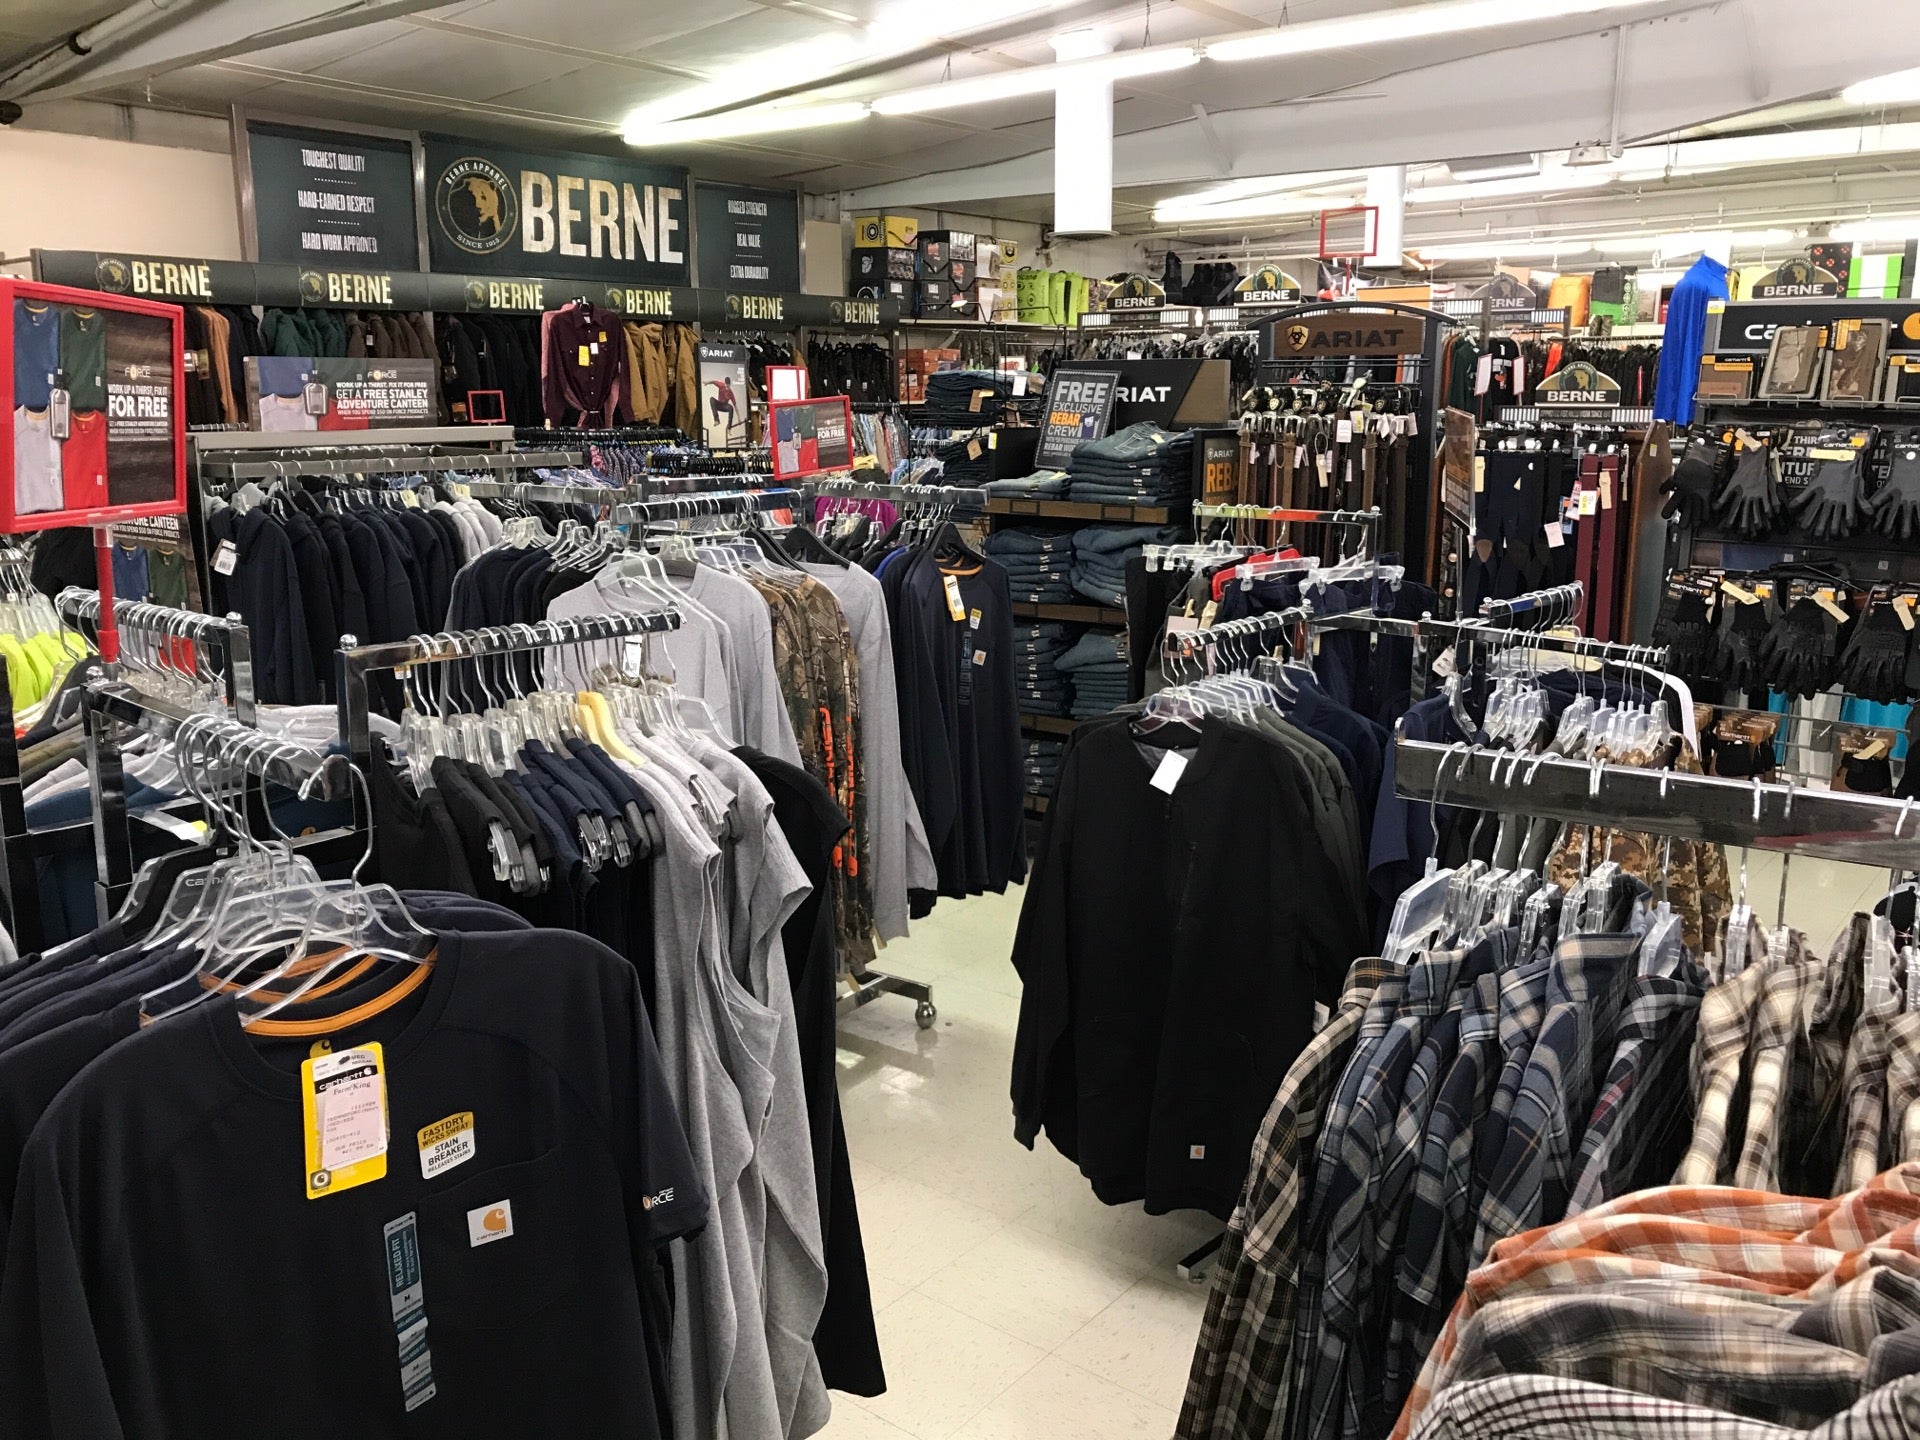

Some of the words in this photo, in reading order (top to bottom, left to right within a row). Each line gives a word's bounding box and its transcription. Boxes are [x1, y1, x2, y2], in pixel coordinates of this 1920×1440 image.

[301, 149, 337, 170] TOUGHEST
[337, 153, 365, 172] QUALITY
[473, 162, 508, 190] APPAREL
[297, 190, 345, 211] HARD-EARNED
[346, 195, 375, 213] RESPECT
[520, 169, 683, 264] BERNE
[301, 232, 321, 250] HARD
[321, 233, 343, 251] WORK
[343, 235, 378, 253] APPROVED
[457, 234, 482, 249] SINCE
[131, 260, 212, 296] BERNE
[327, 272, 393, 304] BERNE
[488, 281, 544, 310] BERNE
[1243, 289, 1290, 302] BERNE
[1763, 284, 1824, 297] BERNE
[625, 288, 672, 316] BERNE
[742, 295, 784, 320] BERNE
[1114, 297, 1156, 308] BERNE
[1490, 298, 1525, 308] ERNE
[844, 300, 880, 325] BERNE
[1311, 329, 1404, 348] ARIAT
[708, 349, 734, 358] ARIAT
[125, 364, 151, 380] FORCE
[367, 369, 397, 381] FORCE
[107, 384, 124, 395] WORK
[124, 384, 131, 395] UP
[131, 385, 135, 395] A
[336, 390, 354, 400] GET
[355, 390, 362, 399] A
[363, 389, 388, 399] FREE
[389, 389, 428, 399] STANLEY
[1055, 381, 1109, 404] FREE
[1116, 386, 1171, 403] RIAT
[1547, 390, 1607, 402] BERNE
[108, 394, 136, 417] FOR
[137, 395, 168, 418] FREE
[337, 399, 389, 409] ADVENTURE
[390, 399, 428, 409] CANTEEN
[1052, 402, 1103, 414] EXCLUSIVE
[1049, 411, 1081, 426] REBAR
[817, 430, 830, 439] FOR
[830, 428, 845, 438] FREE
[1047, 425, 1079, 437] CREW
[1044, 442, 1063, 451] REBAR
[1213, 449, 1234, 459] ARIAT
[422, 1132, 445, 1147] WICKS
[446, 1122, 469, 1137] SWEAT
[423, 1115, 465, 1140] FASTDRY
[428, 1141, 469, 1166] BREAKER
[434, 1136, 459, 1154] STAIN
[427, 1156, 454, 1173] RELEASES
[642, 1190, 674, 1210] ORCE
